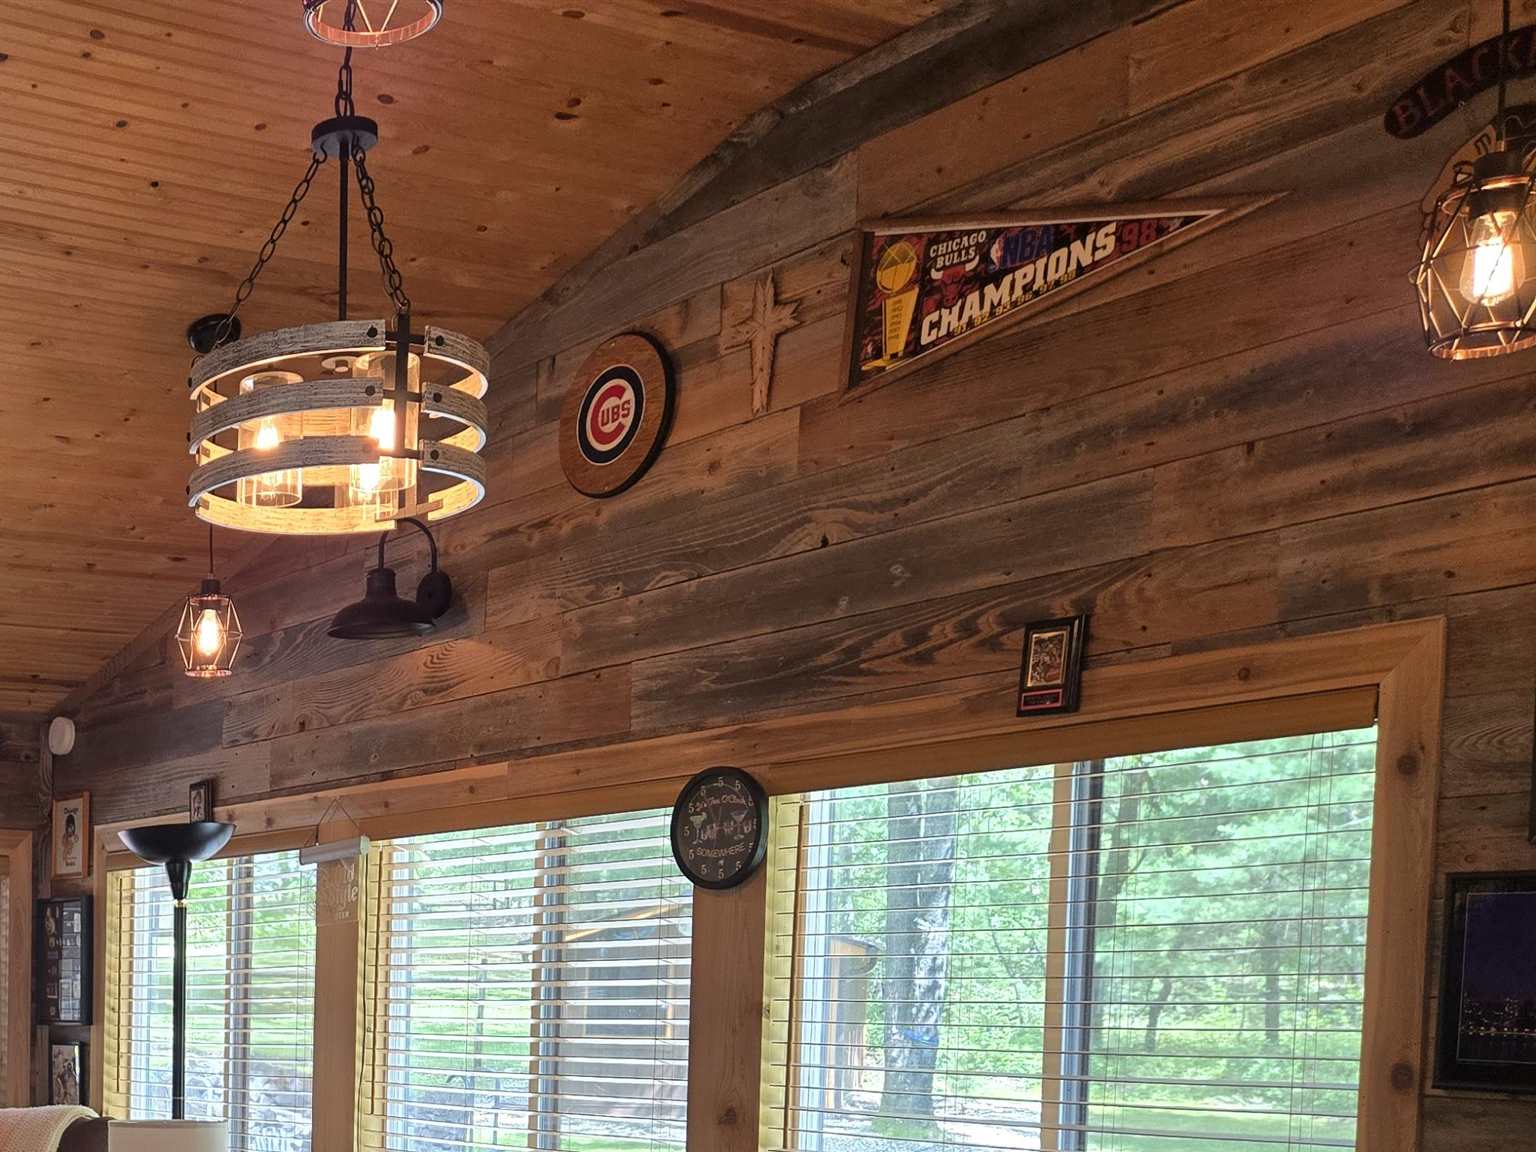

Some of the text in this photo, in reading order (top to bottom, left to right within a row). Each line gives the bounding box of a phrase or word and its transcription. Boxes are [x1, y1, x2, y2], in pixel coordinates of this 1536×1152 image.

[1394, 33, 1536, 134] BLACK
[929, 230, 986, 258] CHICAGO
[935, 246, 976, 269] BULLS
[1004, 224, 1054, 268] NBA
[920, 222, 1117, 346] CHAMPIONS
[590, 384, 631, 446] CUBS
